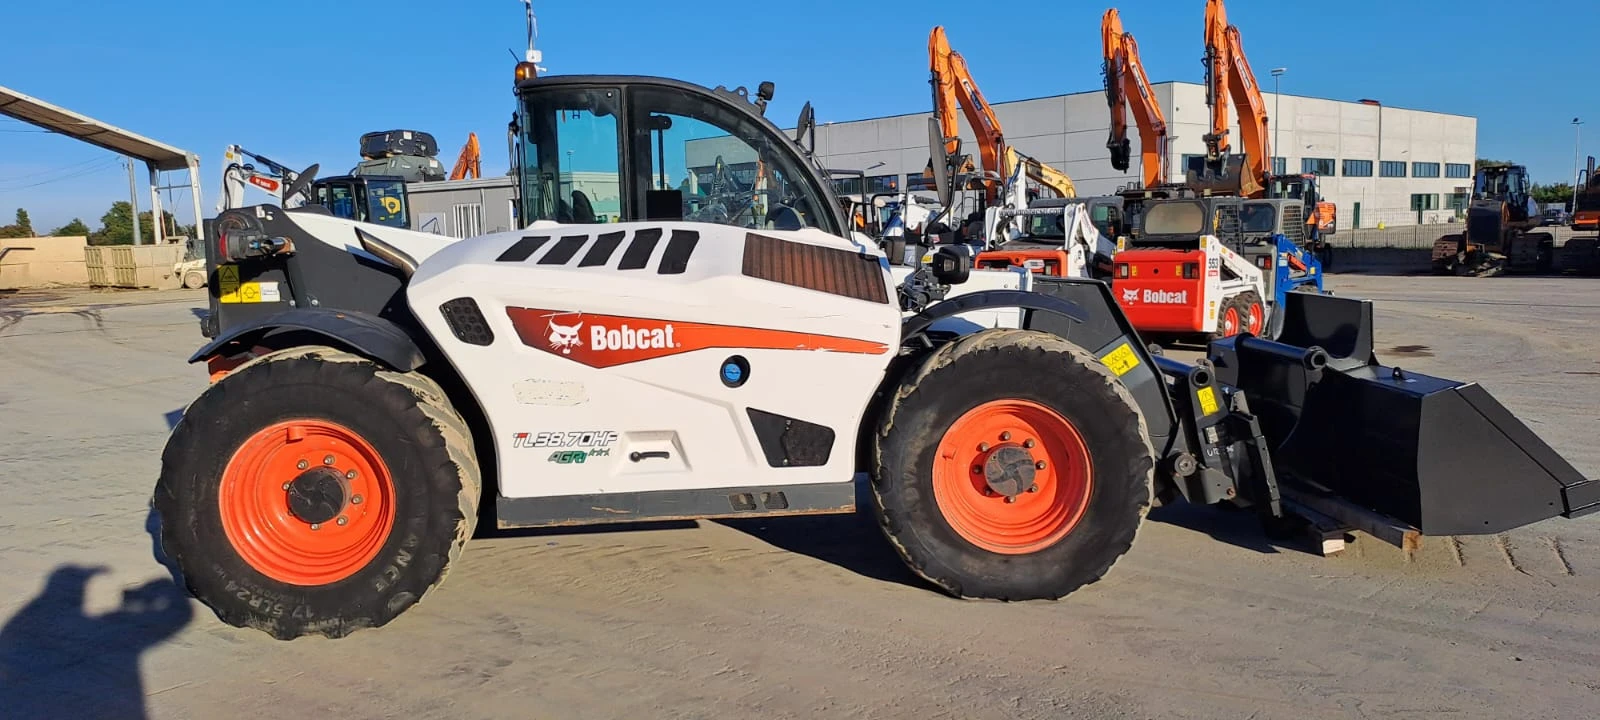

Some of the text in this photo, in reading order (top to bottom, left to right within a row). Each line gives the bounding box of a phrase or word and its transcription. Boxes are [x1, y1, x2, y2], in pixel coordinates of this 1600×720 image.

[1208, 258, 1218, 269] 553
[1143, 289, 1187, 304] Bobcat
[590, 324, 675, 351] Bobcat
[512, 430, 619, 448] TL38.70HF
[547, 450, 588, 464] AGRI
